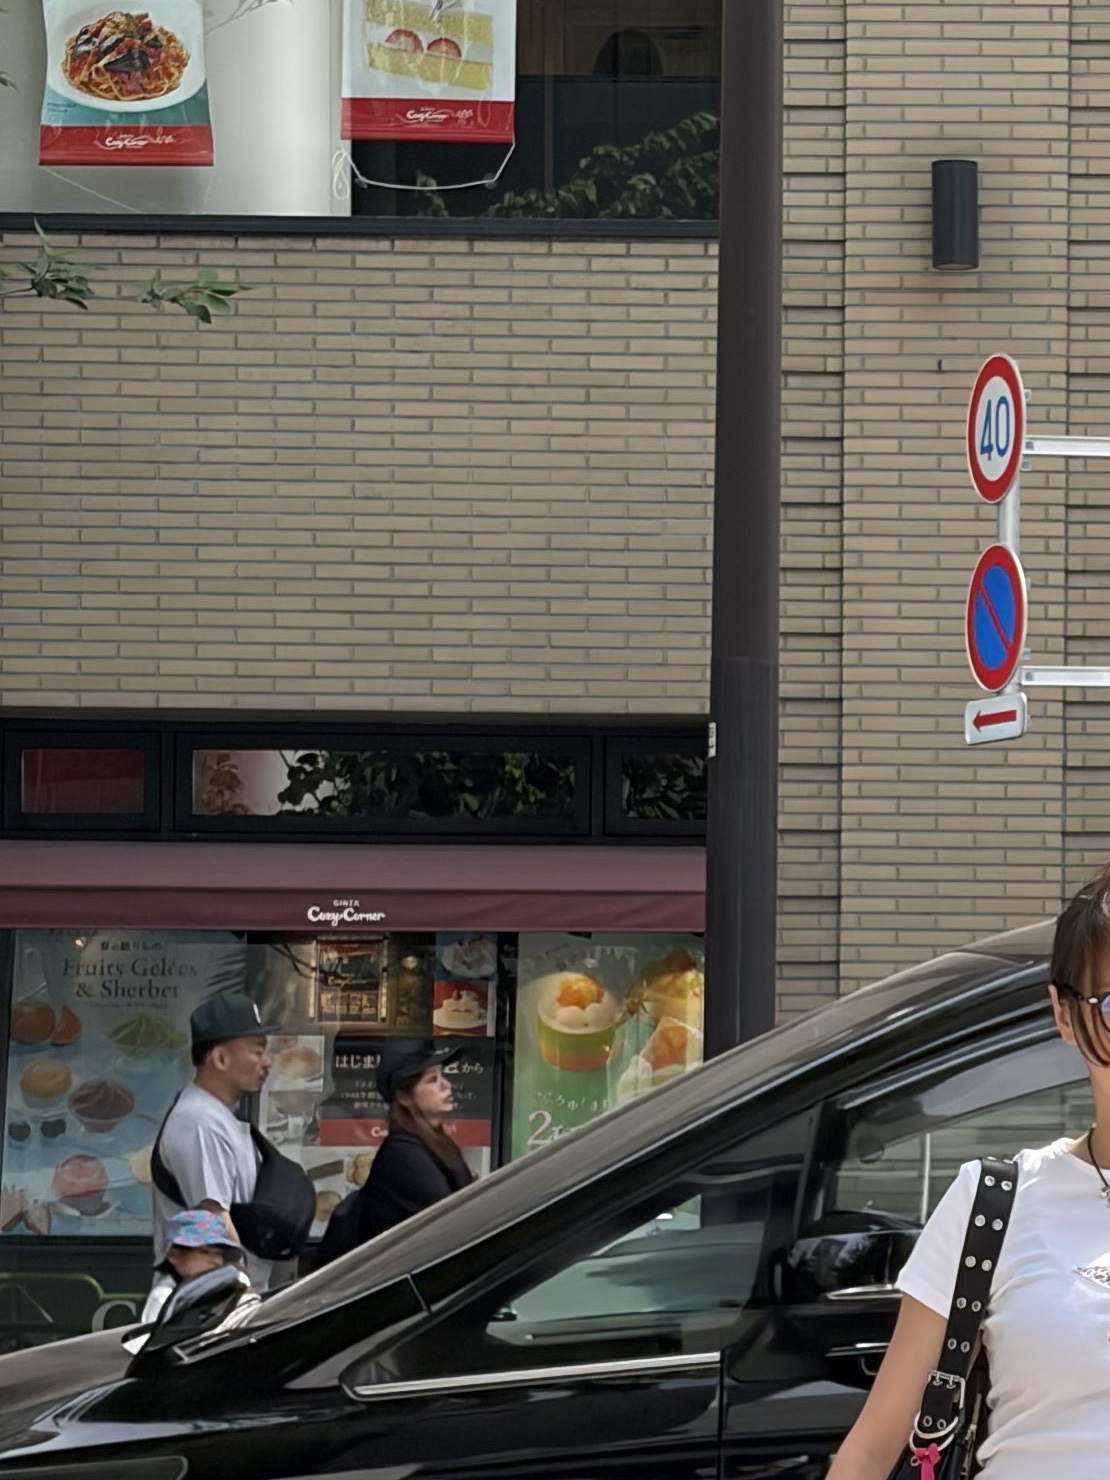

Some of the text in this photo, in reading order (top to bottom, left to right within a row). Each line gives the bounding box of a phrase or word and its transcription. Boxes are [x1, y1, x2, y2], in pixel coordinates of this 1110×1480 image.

[980, 396, 1010, 461] 40
[63, 958, 123, 976] Fruits
[75, 979, 178, 998] & Sherbet
